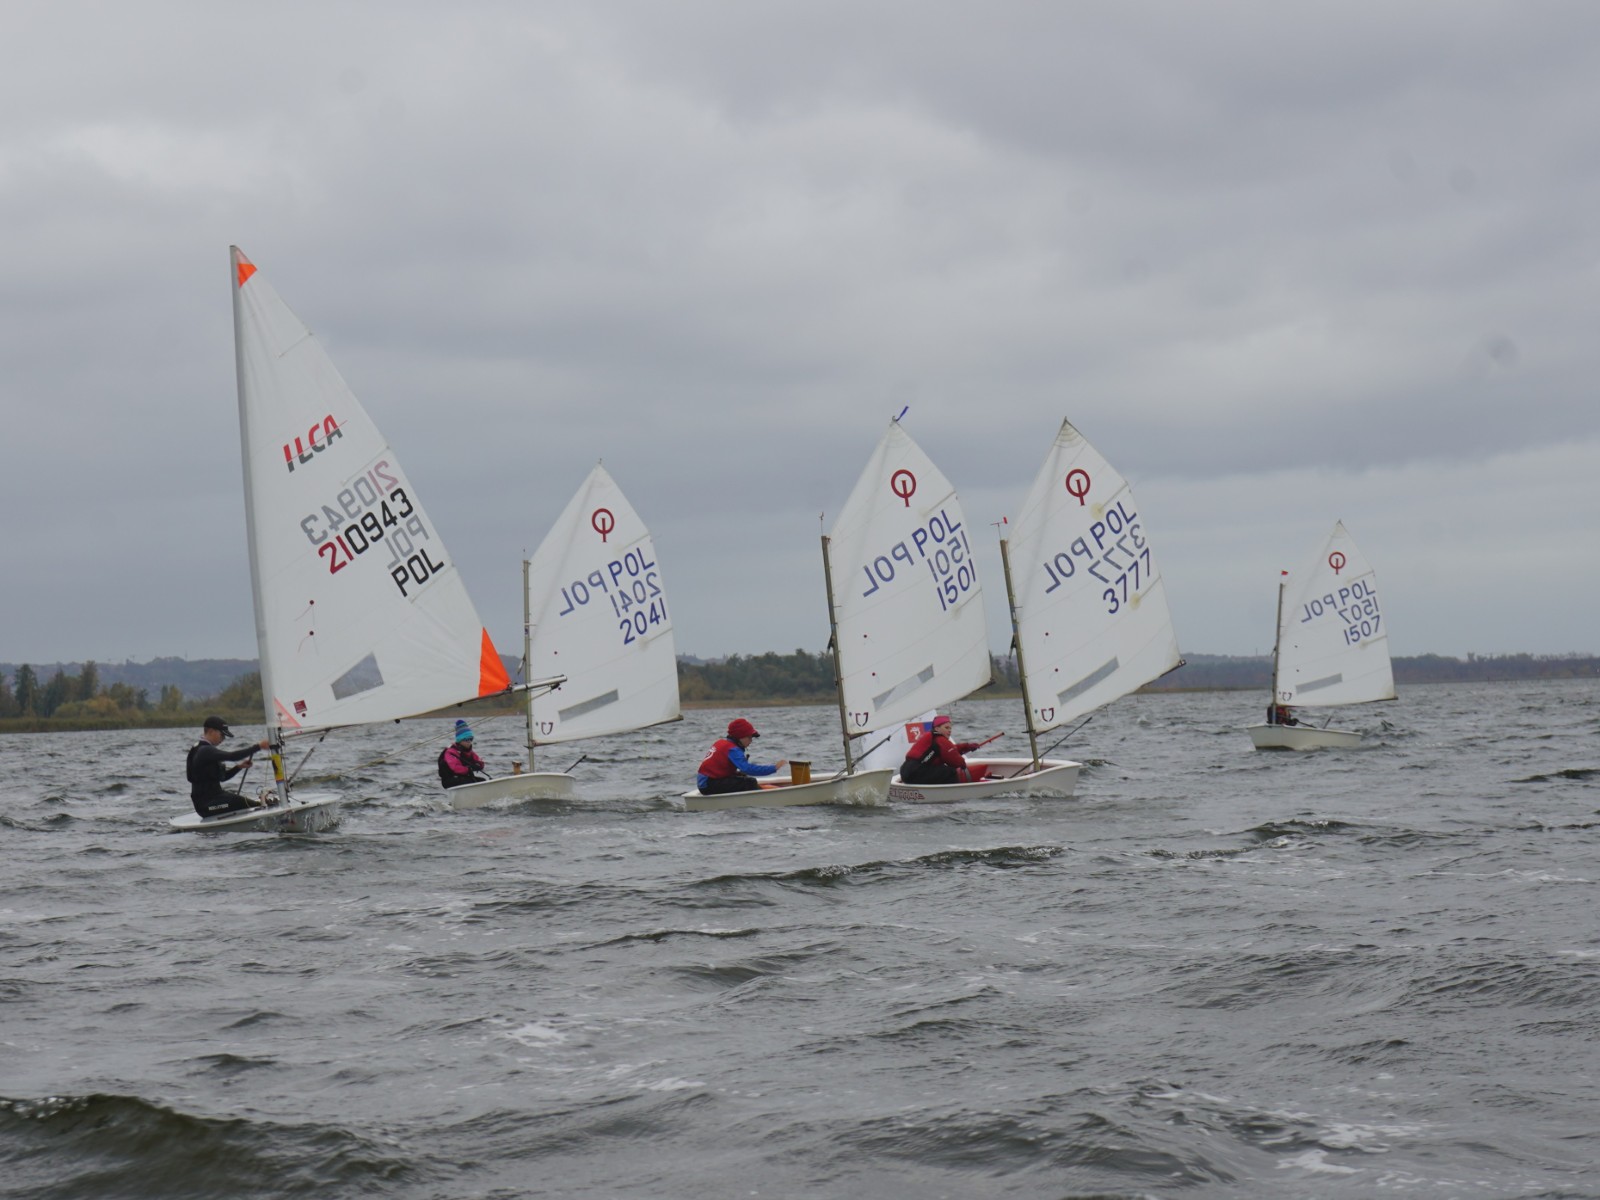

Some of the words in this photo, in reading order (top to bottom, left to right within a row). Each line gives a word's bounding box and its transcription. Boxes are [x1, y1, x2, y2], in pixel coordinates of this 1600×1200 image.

[283, 414, 343, 473] ILCA
[318, 487, 414, 575] 210943
[911, 509, 962, 557] POL
[1089, 501, 1137, 550] POL
[391, 548, 445, 597] POL
[608, 547, 655, 587] POL
[937, 558, 976, 611] 1501
[1103, 547, 1150, 614] 3777
[1338, 580, 1376, 606] POL
[619, 597, 667, 645] 2041
[1344, 614, 1380, 645] 1507
